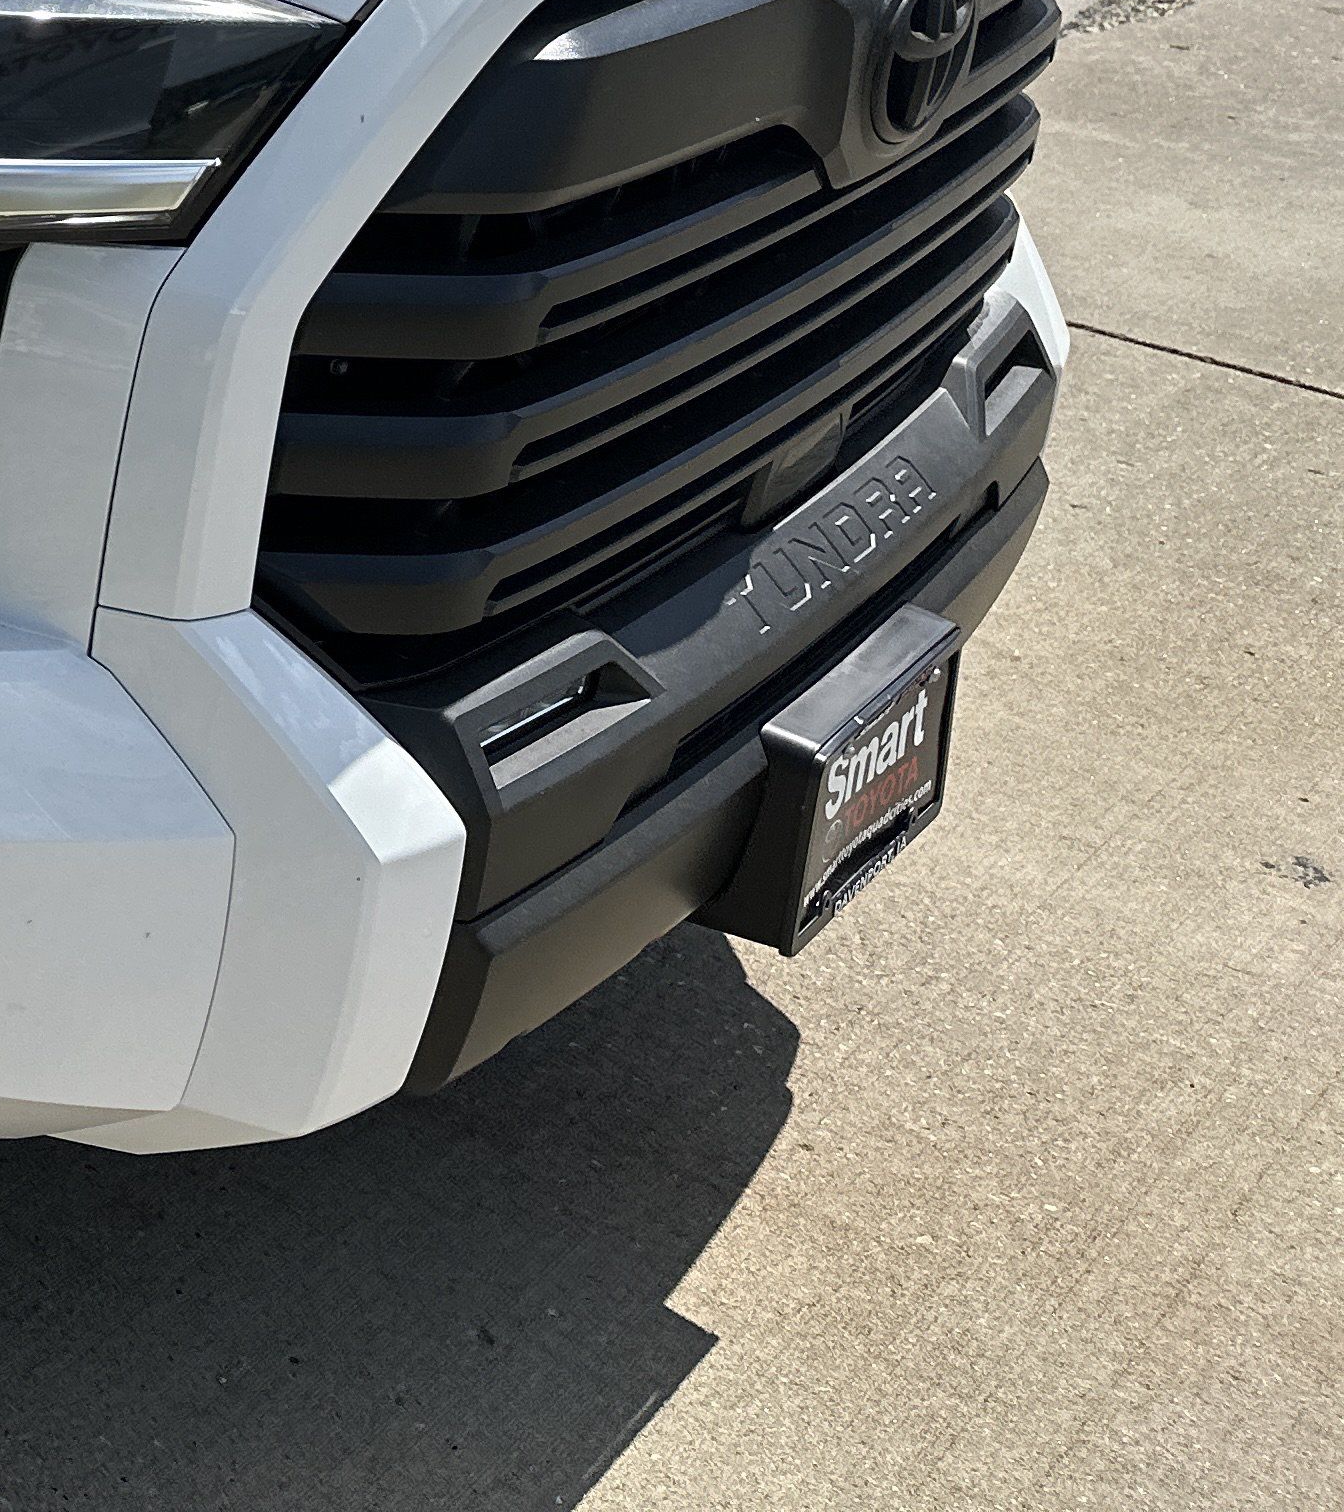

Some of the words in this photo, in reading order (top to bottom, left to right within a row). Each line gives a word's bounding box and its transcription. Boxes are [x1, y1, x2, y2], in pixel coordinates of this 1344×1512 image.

[725, 455, 937, 634] TUNDRA
[824, 689, 928, 820] Smart
[843, 756, 919, 833] TOYOTA
